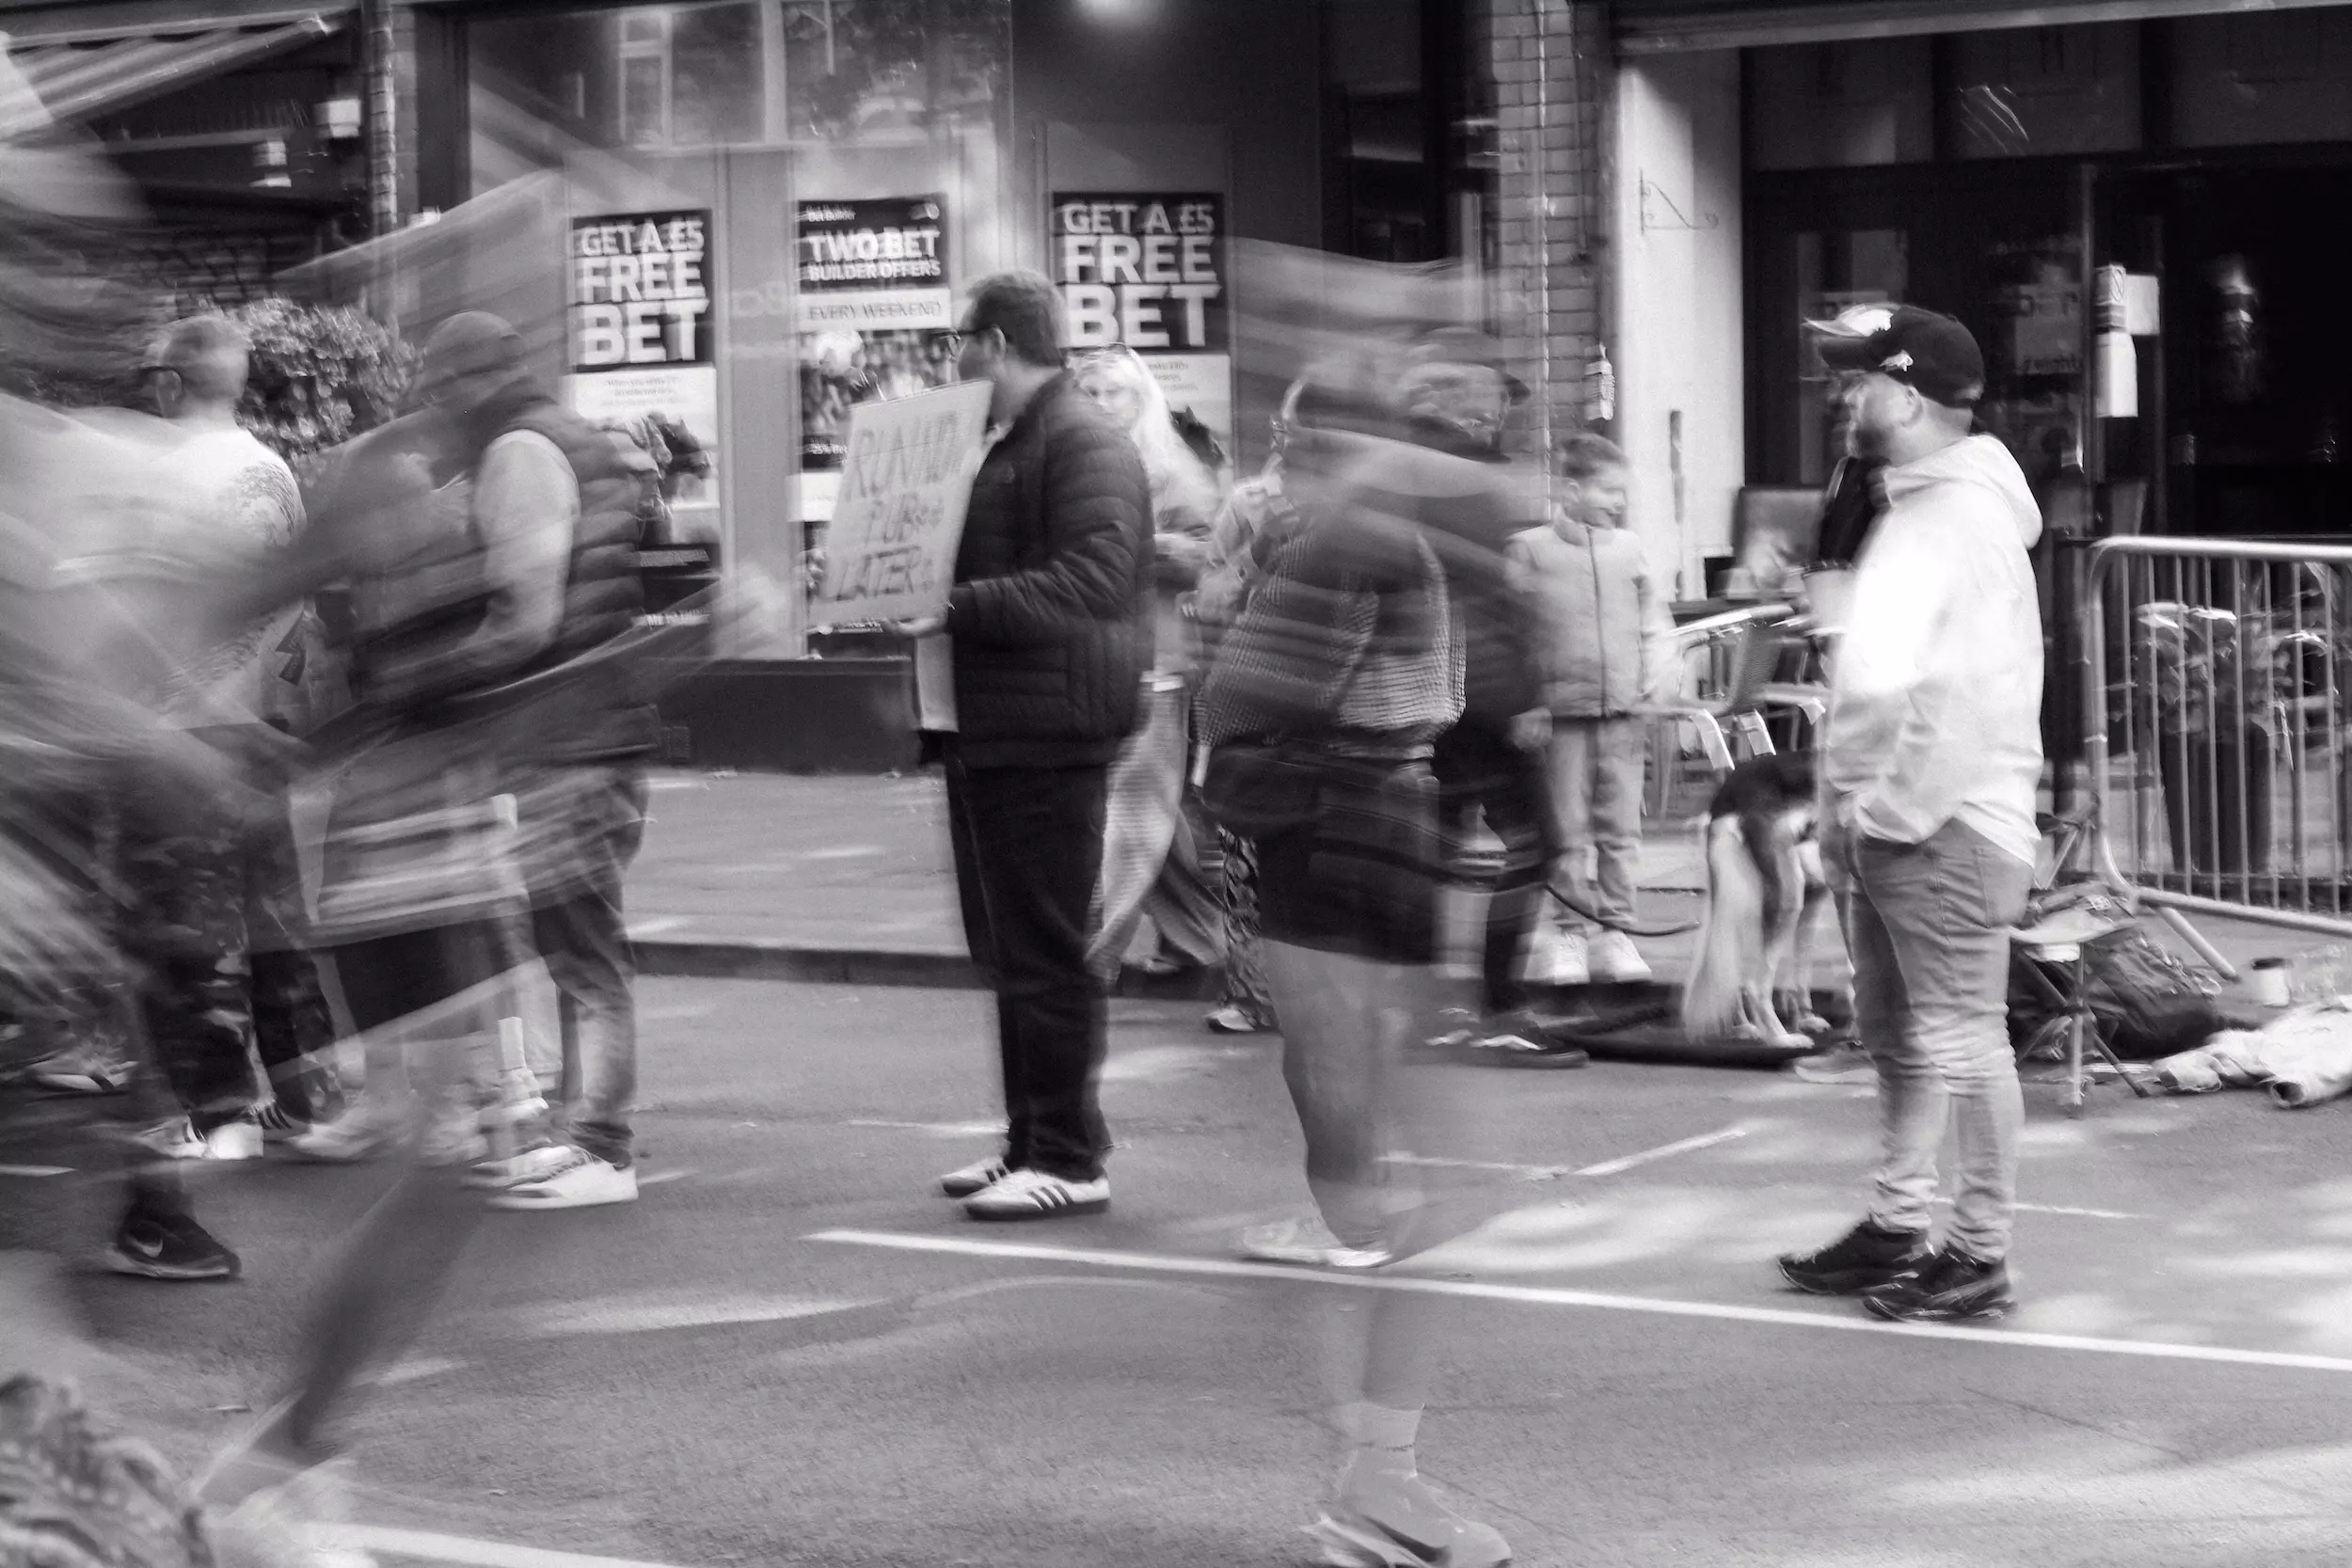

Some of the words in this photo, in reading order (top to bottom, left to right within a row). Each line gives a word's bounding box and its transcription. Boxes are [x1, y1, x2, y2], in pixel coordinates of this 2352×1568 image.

[580, 224, 636, 256] GET
[640, 218, 664, 253] A
[1061, 202, 1137, 234] GET
[1144, 202, 1172, 234] A
[807, 230, 879, 262] TWO
[884, 228, 941, 260] BET
[1064, 234, 1217, 283] FREE
[580, 251, 706, 303] FREE
[808, 262, 878, 281] BUILDER
[880, 259, 941, 278] OFFERS
[808, 304, 856, 321] EVERY
[862, 300, 942, 320] WEEKEND
[1065, 283, 1222, 348] BET
[580, 298, 710, 365] BET
